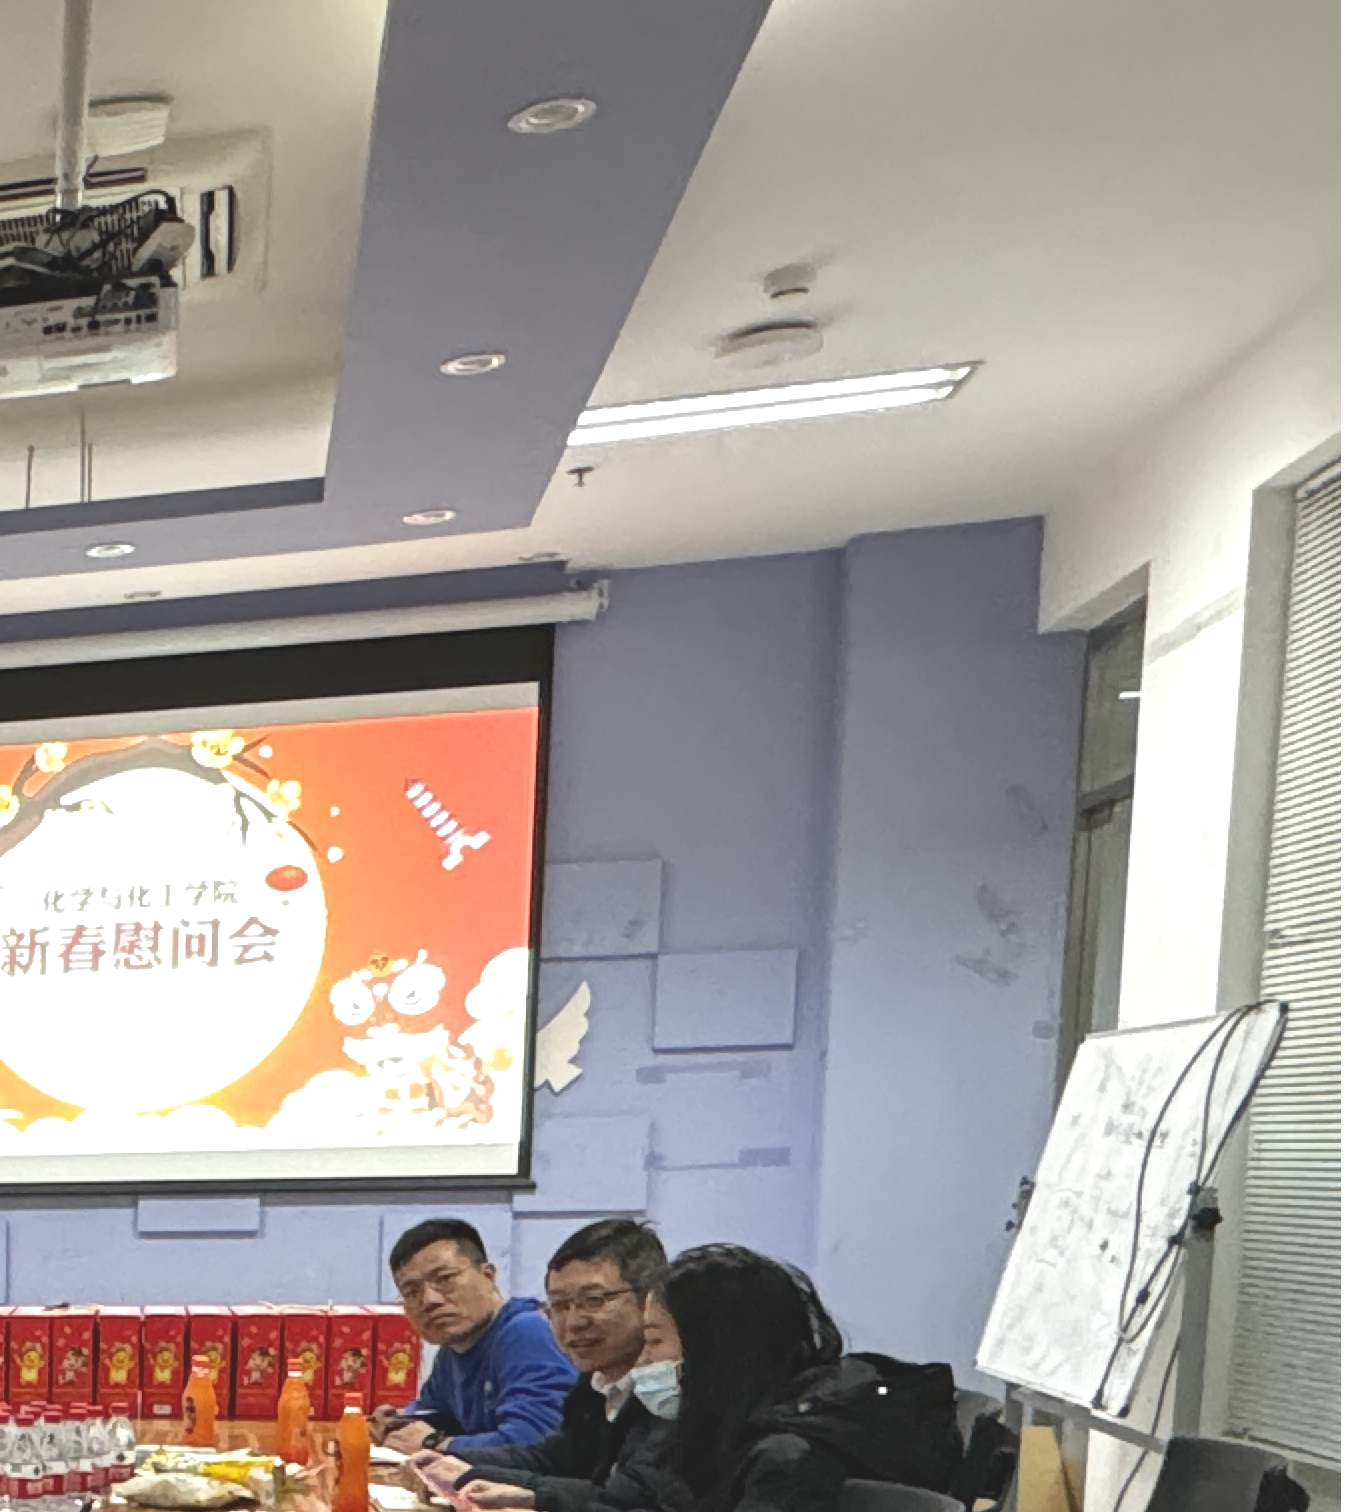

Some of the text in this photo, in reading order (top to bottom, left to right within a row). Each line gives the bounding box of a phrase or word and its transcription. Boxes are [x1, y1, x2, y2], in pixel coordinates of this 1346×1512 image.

[0, 916, 281, 977] 新春慰问会
